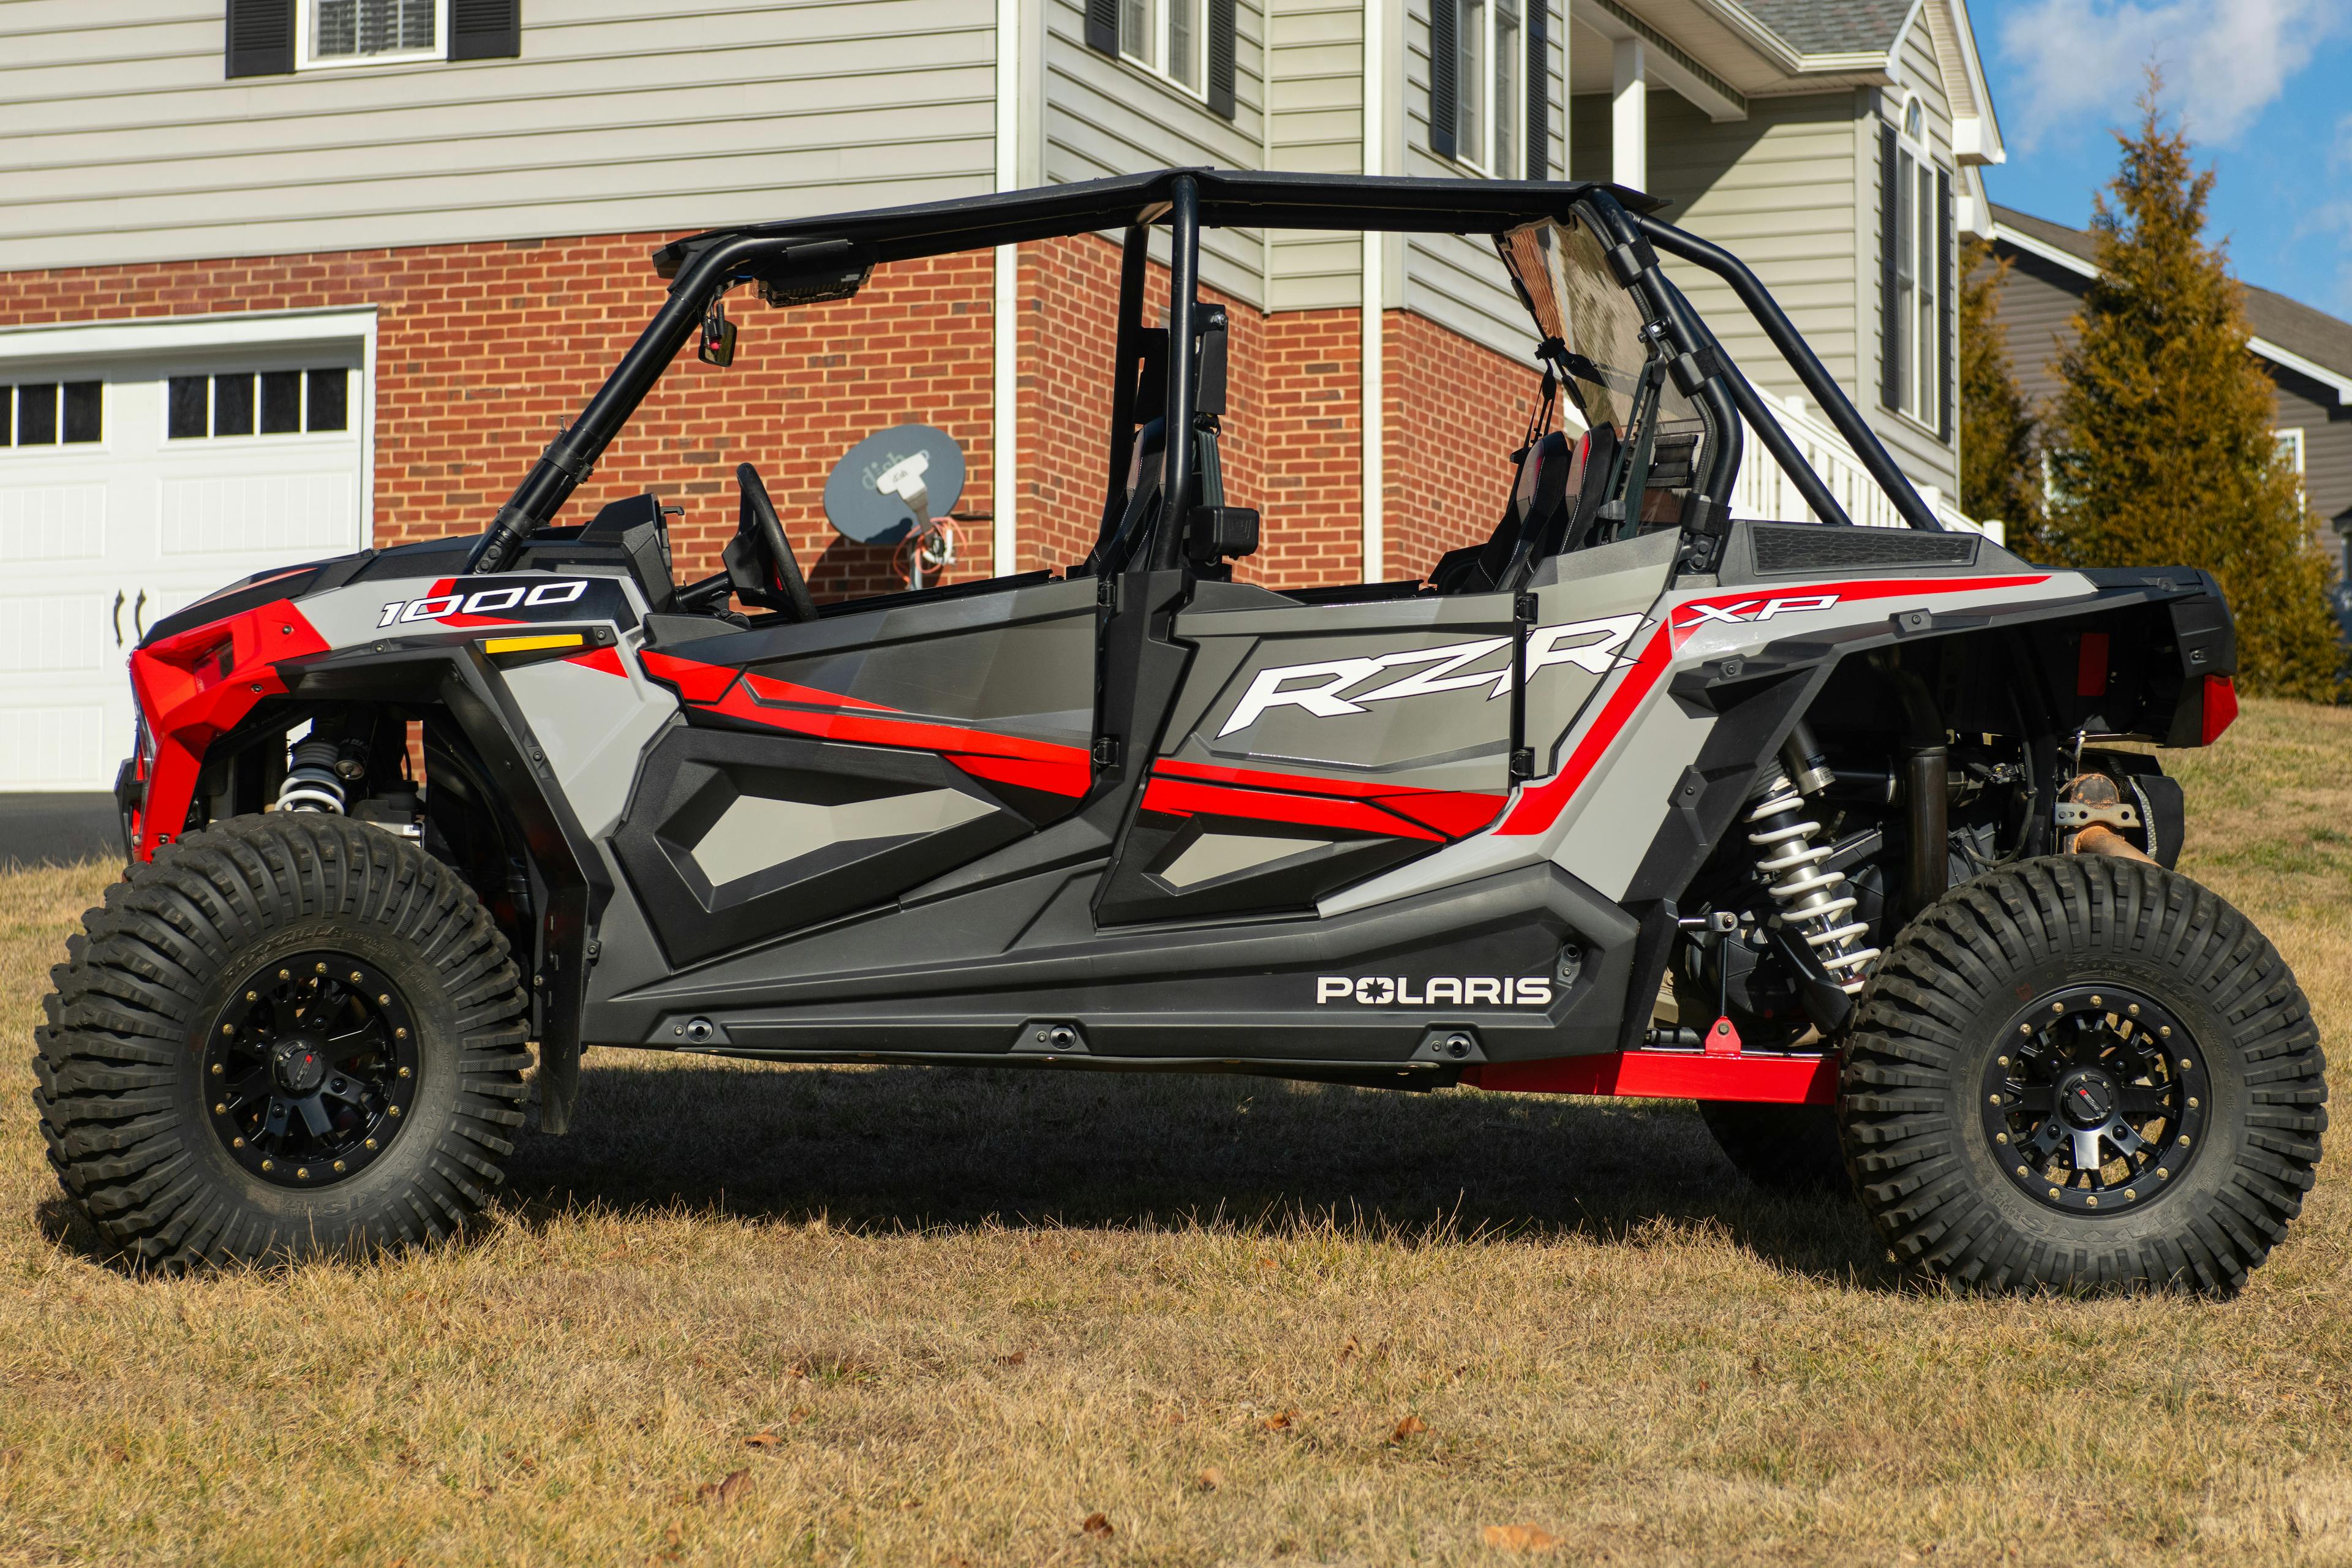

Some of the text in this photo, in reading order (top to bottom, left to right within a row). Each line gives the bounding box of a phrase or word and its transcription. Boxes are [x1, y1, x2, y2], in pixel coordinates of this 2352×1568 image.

[377, 581, 588, 628] 1000
[1672, 594, 1842, 628] XP
[1214, 612, 1656, 741] RZR
[1316, 976, 1552, 1005] POLARIS
